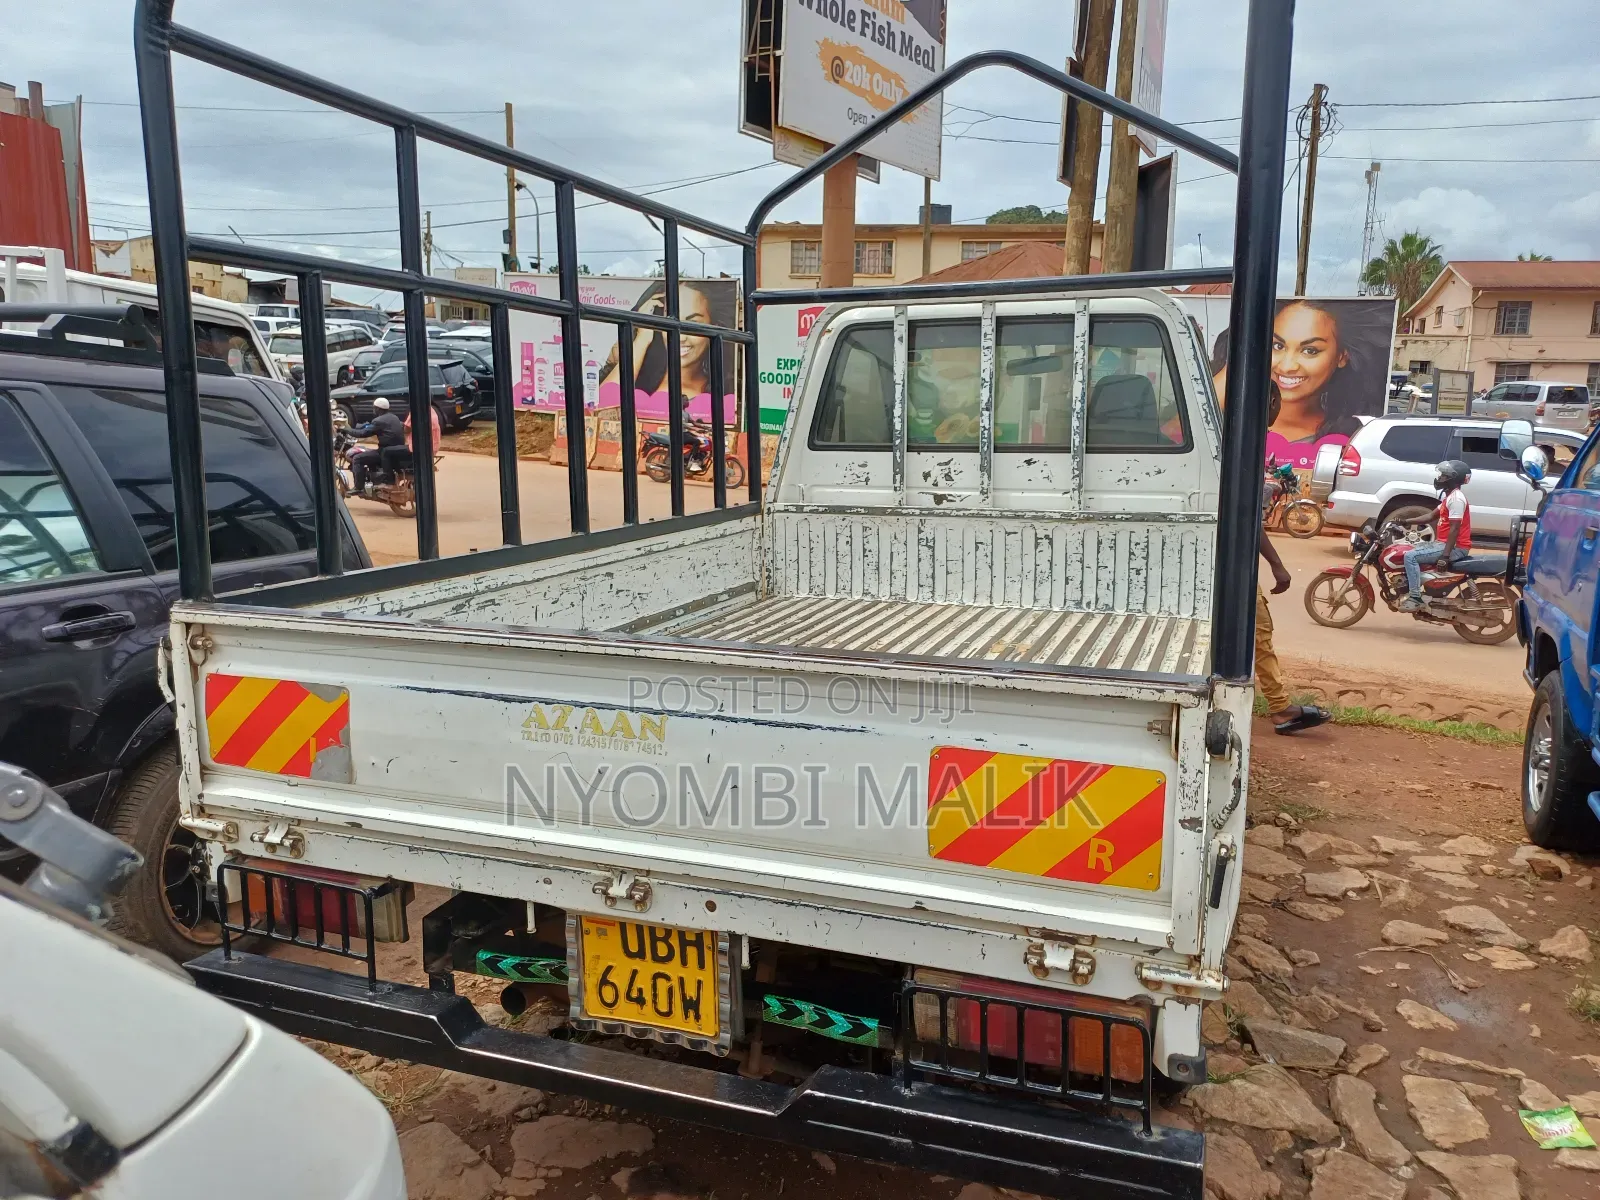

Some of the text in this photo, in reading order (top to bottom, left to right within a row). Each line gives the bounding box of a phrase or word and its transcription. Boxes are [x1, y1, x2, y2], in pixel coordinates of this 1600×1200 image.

[859, 9, 897, 53] Fish
[898, 30, 936, 73] Meal
[831, 55, 871, 91] @20k
[847, 107, 868, 125] Open
[593, 294, 617, 305] Goals
[521, 703, 669, 743] AZAAN
[1087, 838, 1115, 873] R
[598, 964, 704, 1023] 640W
